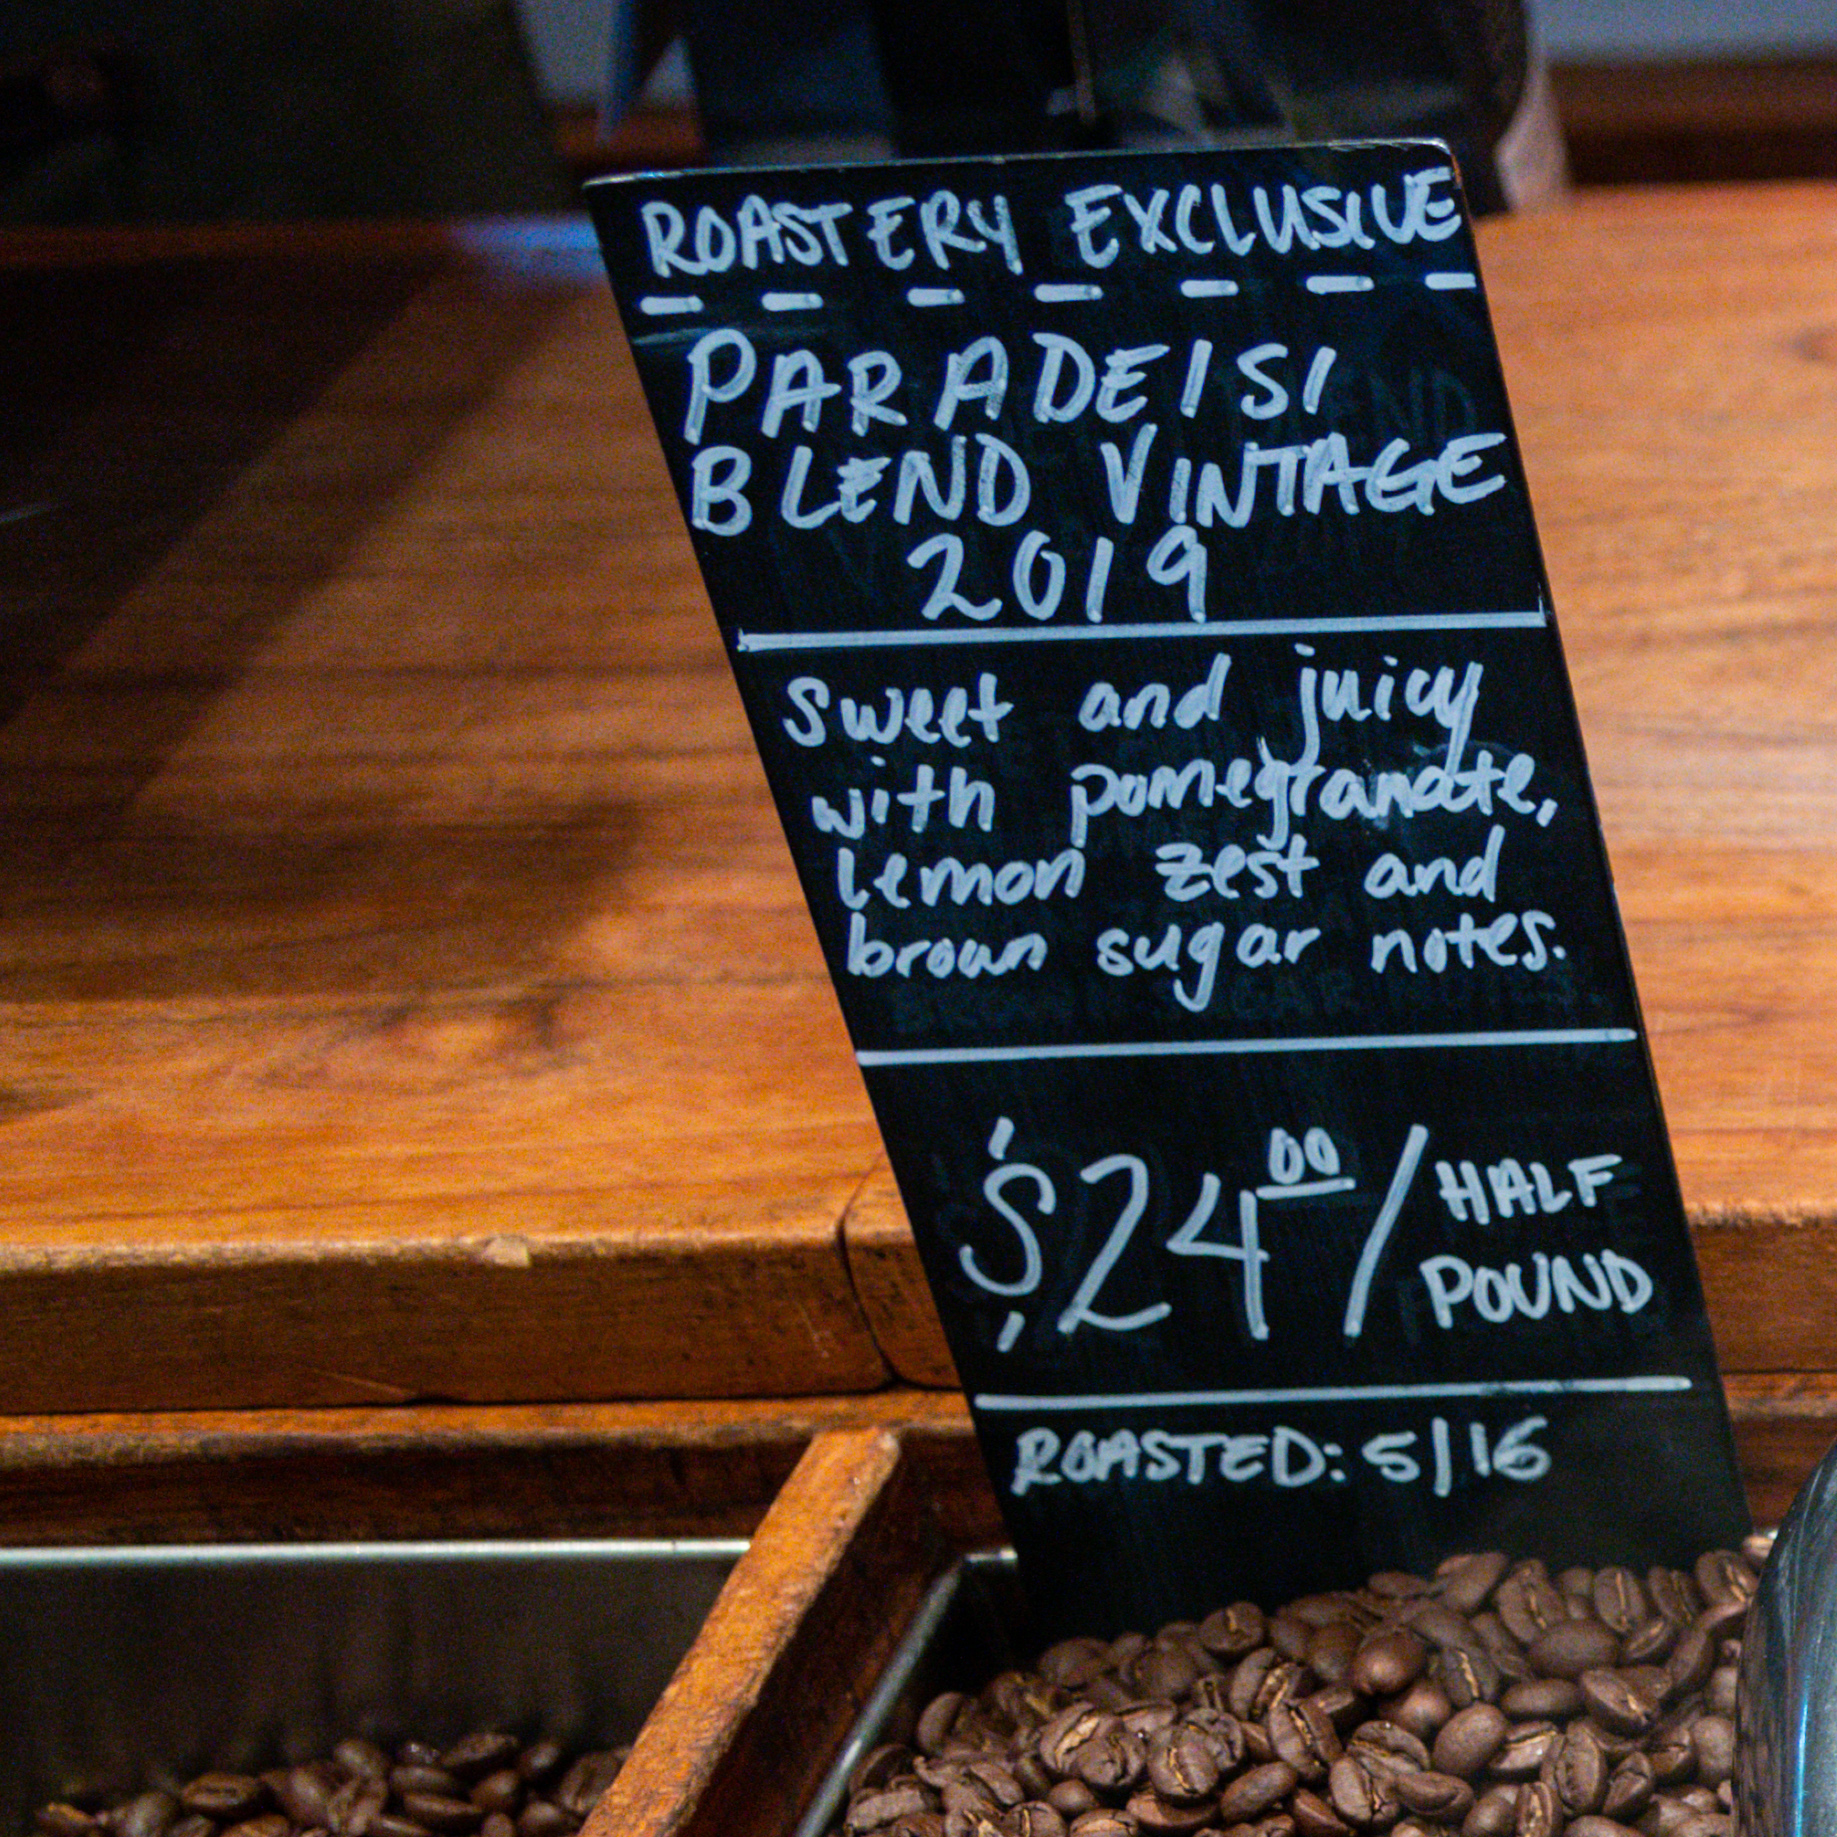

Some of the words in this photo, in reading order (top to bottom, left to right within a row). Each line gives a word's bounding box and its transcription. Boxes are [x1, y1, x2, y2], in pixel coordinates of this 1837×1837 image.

[642, 192, 1022, 276] ROASTERY
[1066, 167, 1464, 269] EXCLUSIVE
[684, 330, 1336, 442] PARADEISI
[691, 435, 1031, 536] BLEND
[1100, 423, 1506, 528] VINTAGE
[908, 529, 1209, 625] 2019
[1078, 652, 1232, 732] and
[1294, 645, 1483, 786] juicy
[812, 756, 995, 839] with
[1156, 836, 1320, 903] zest
[1365, 825, 1506, 904] and
[846, 913, 1048, 979] brown
[1097, 921, 1321, 1012] sugar
[1370, 910, 1565, 975] notes.
[1435, 1153, 1622, 1225] HALF
[1420, 1250, 1654, 1329] POUND
